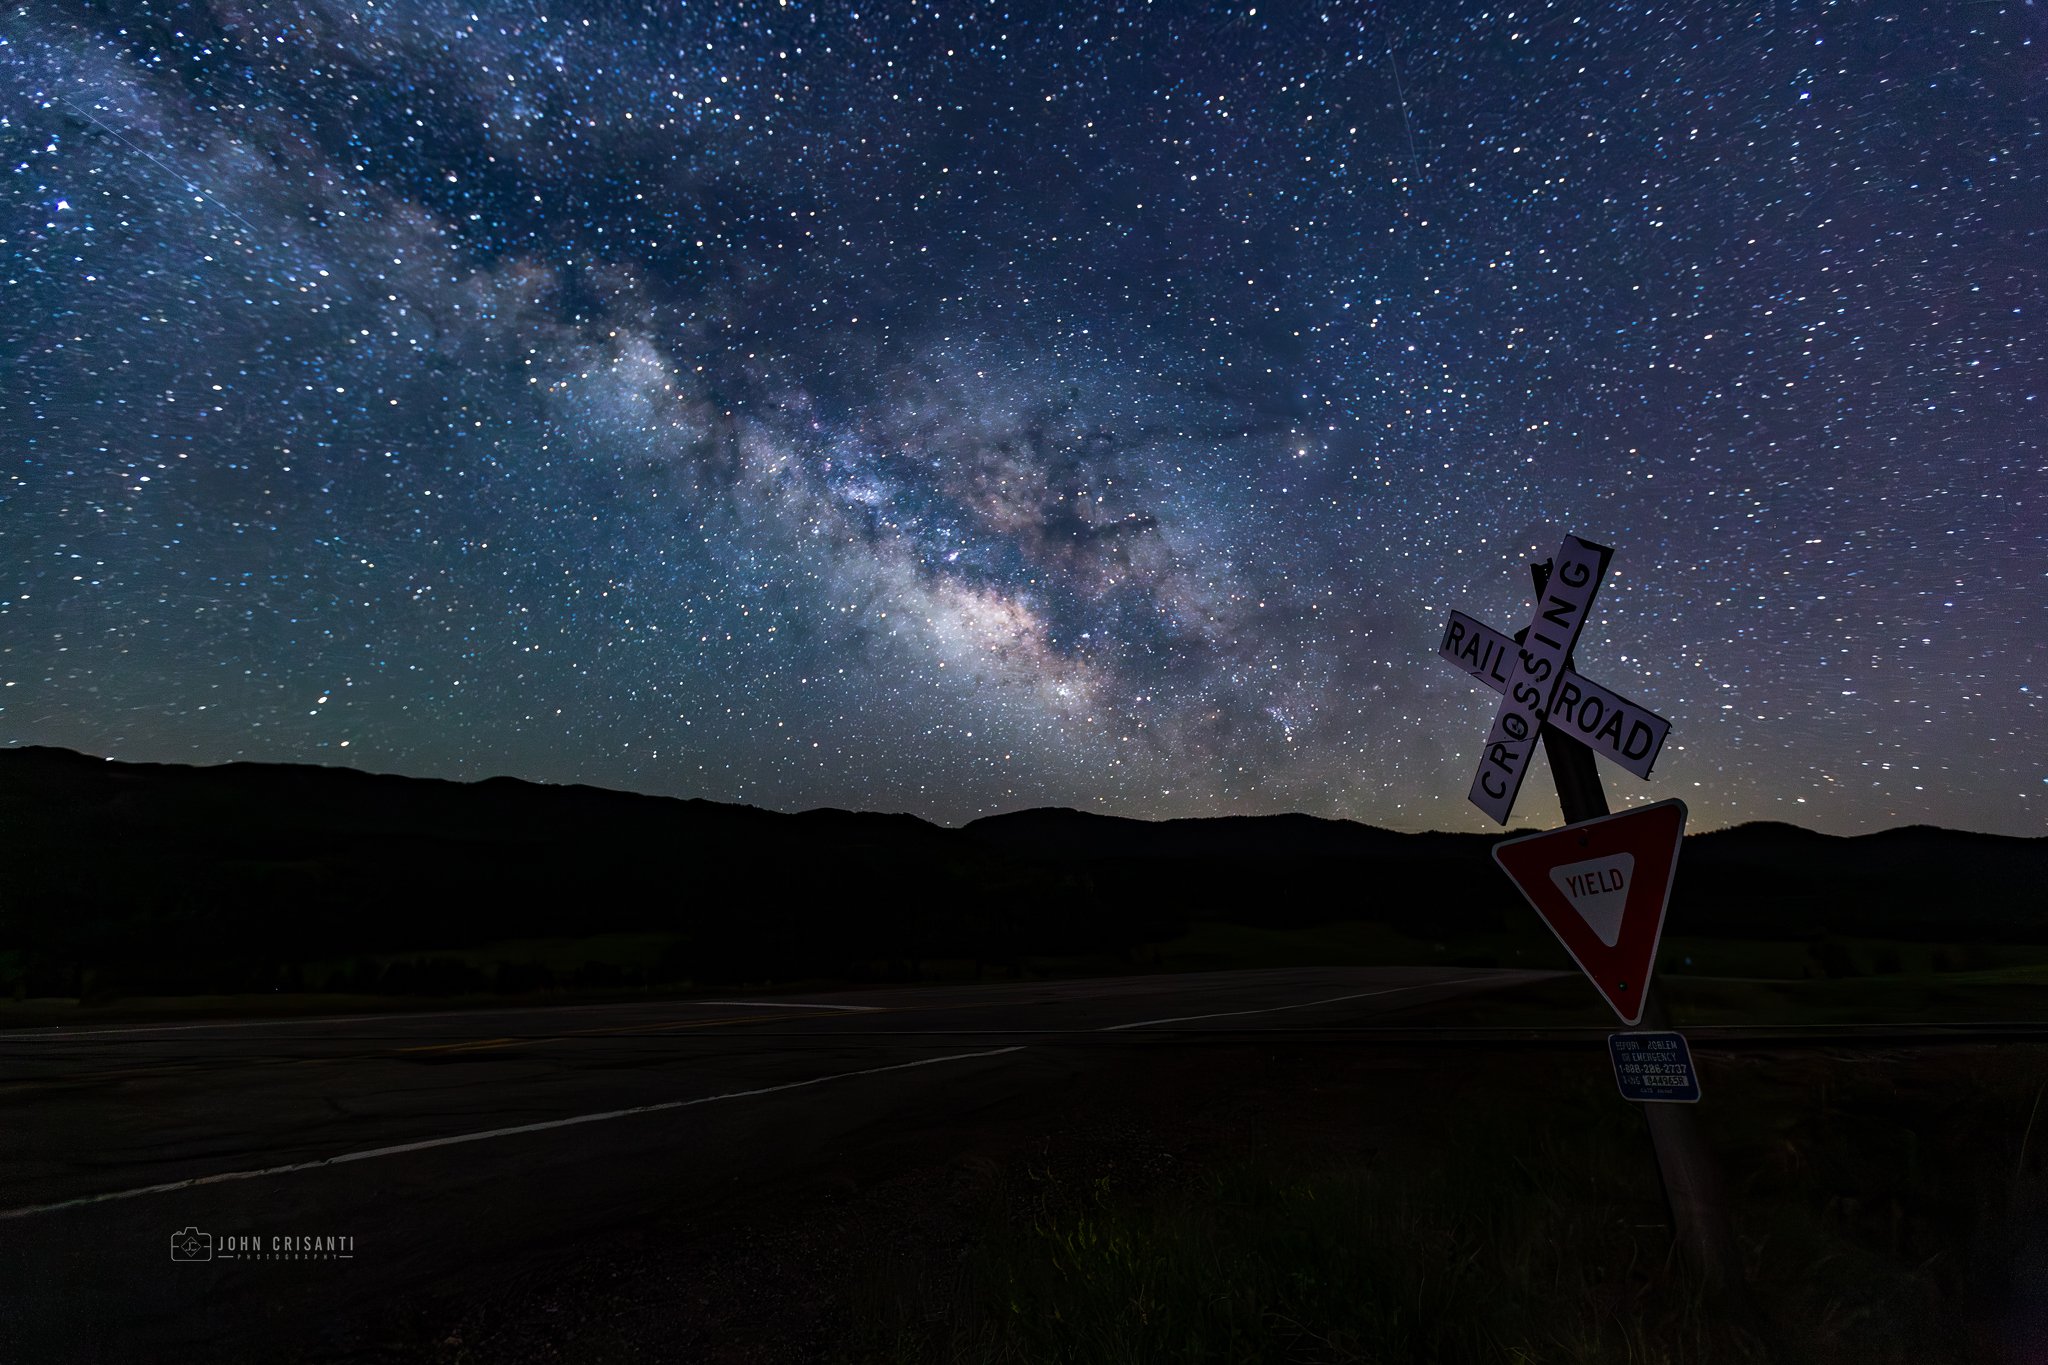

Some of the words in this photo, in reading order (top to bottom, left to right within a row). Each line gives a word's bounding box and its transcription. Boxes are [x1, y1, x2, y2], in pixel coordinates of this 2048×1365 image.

[1445, 620, 1507, 684] RAIL
[1553, 682, 1654, 761] ROAD
[1481, 560, 1591, 800] CROSSING
[1566, 869, 1624, 898] YIELD
[1631, 1052, 1677, 1062] EMERGENCY
